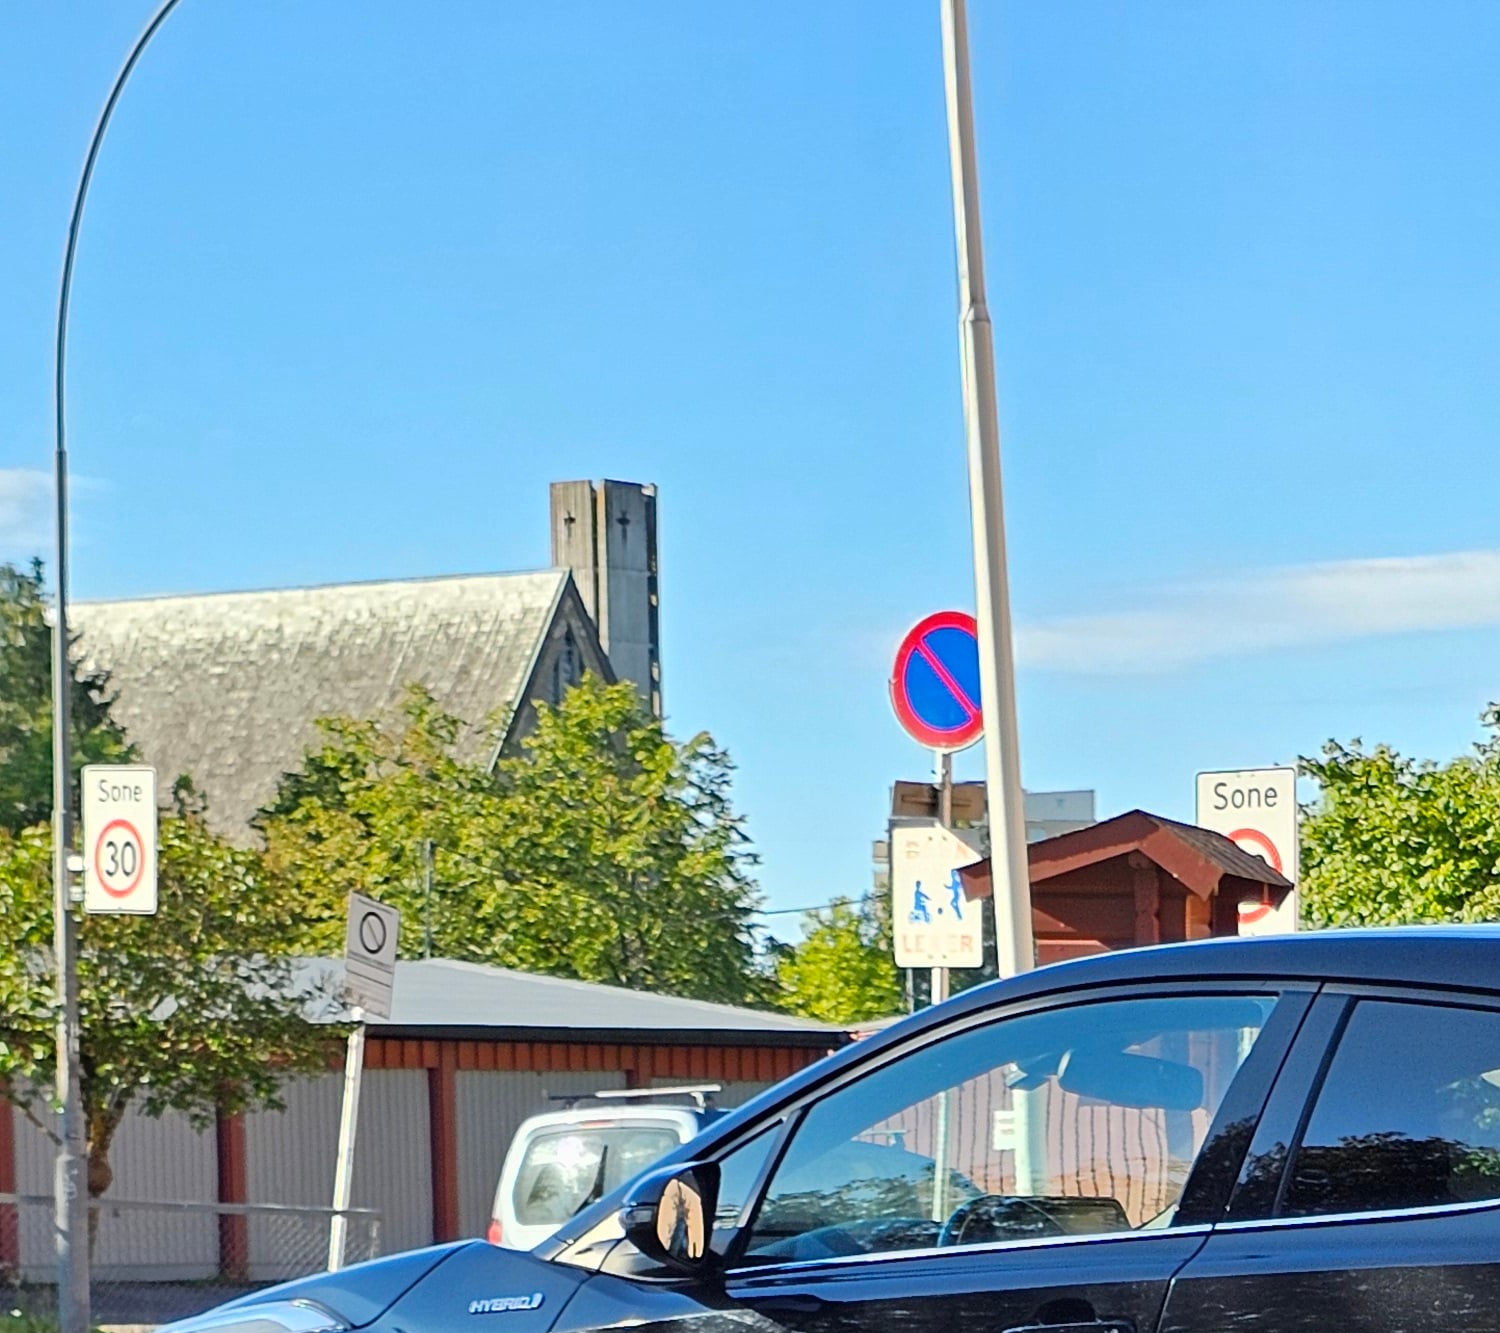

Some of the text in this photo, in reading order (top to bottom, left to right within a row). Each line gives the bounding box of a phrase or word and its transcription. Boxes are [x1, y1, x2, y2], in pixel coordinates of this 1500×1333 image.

[98, 779, 143, 803] Sone
[1213, 782, 1278, 810] Sone
[105, 841, 137, 877] 30
[467, 1296, 533, 1313] HYBRID
